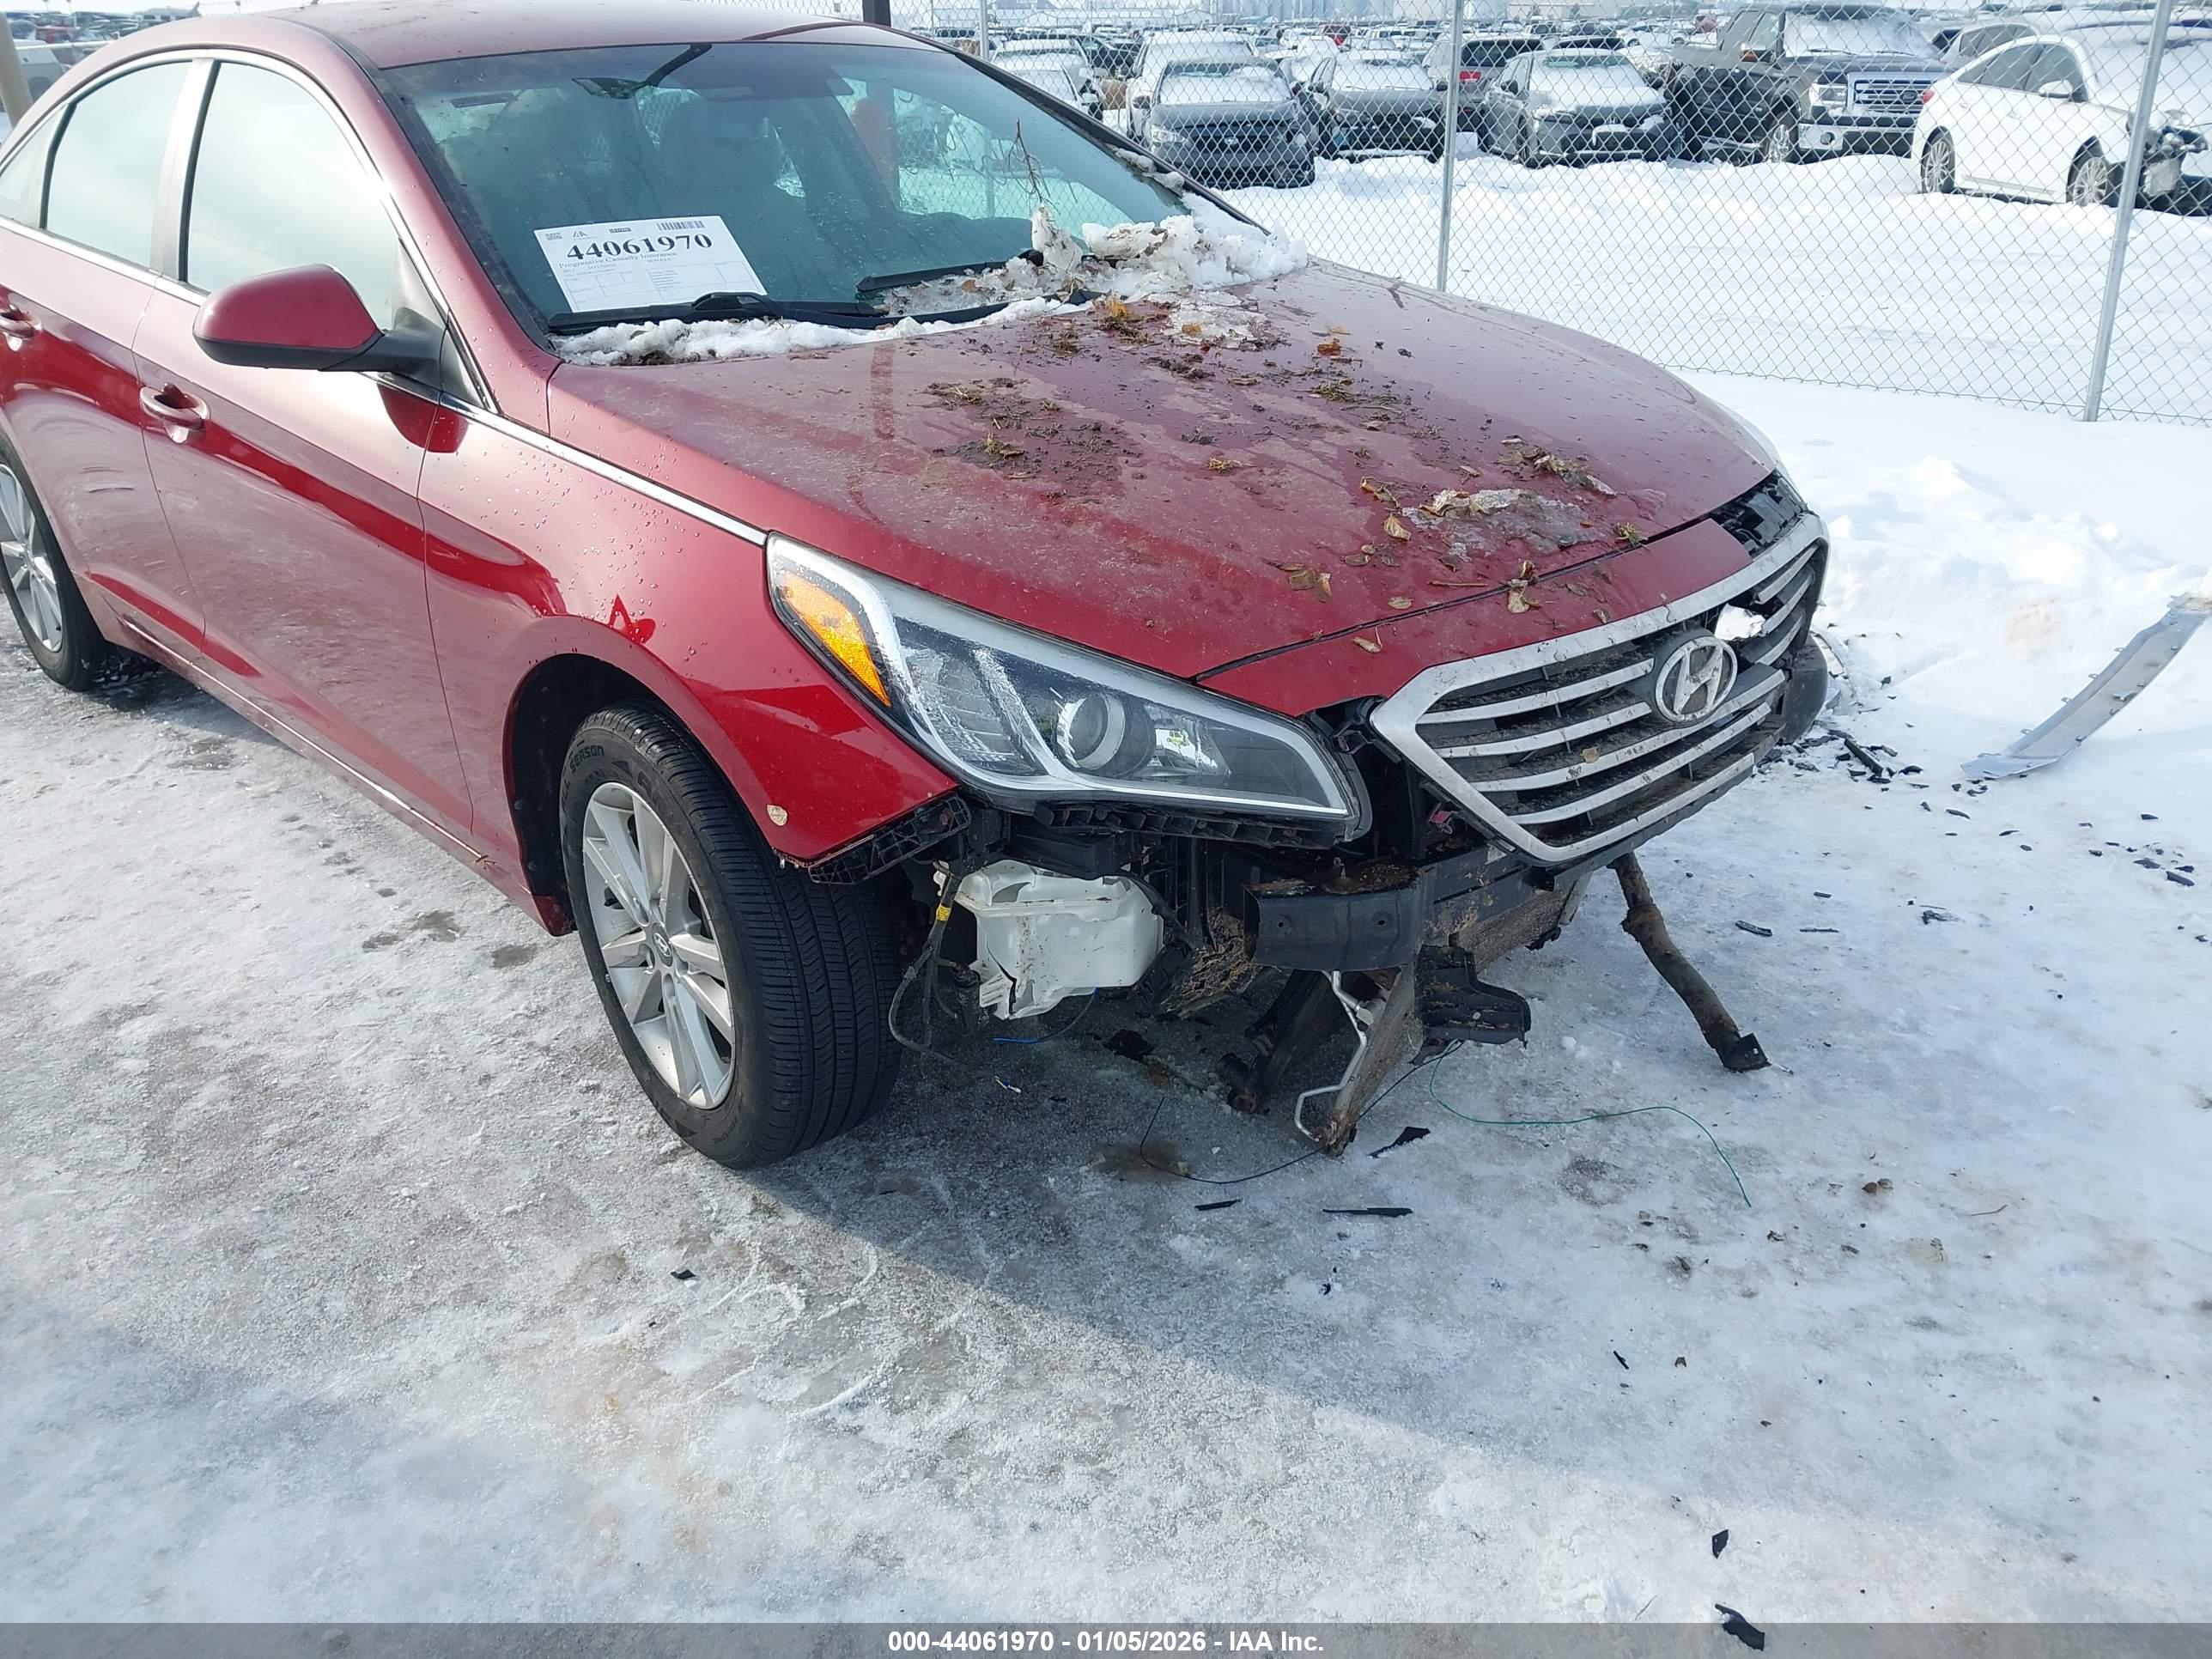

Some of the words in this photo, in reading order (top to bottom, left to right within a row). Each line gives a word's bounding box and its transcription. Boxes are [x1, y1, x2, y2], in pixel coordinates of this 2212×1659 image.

[567, 234, 713, 260] 44061970
[558, 258, 604, 269] Progressive
[605, 252, 638, 264] Casualty
